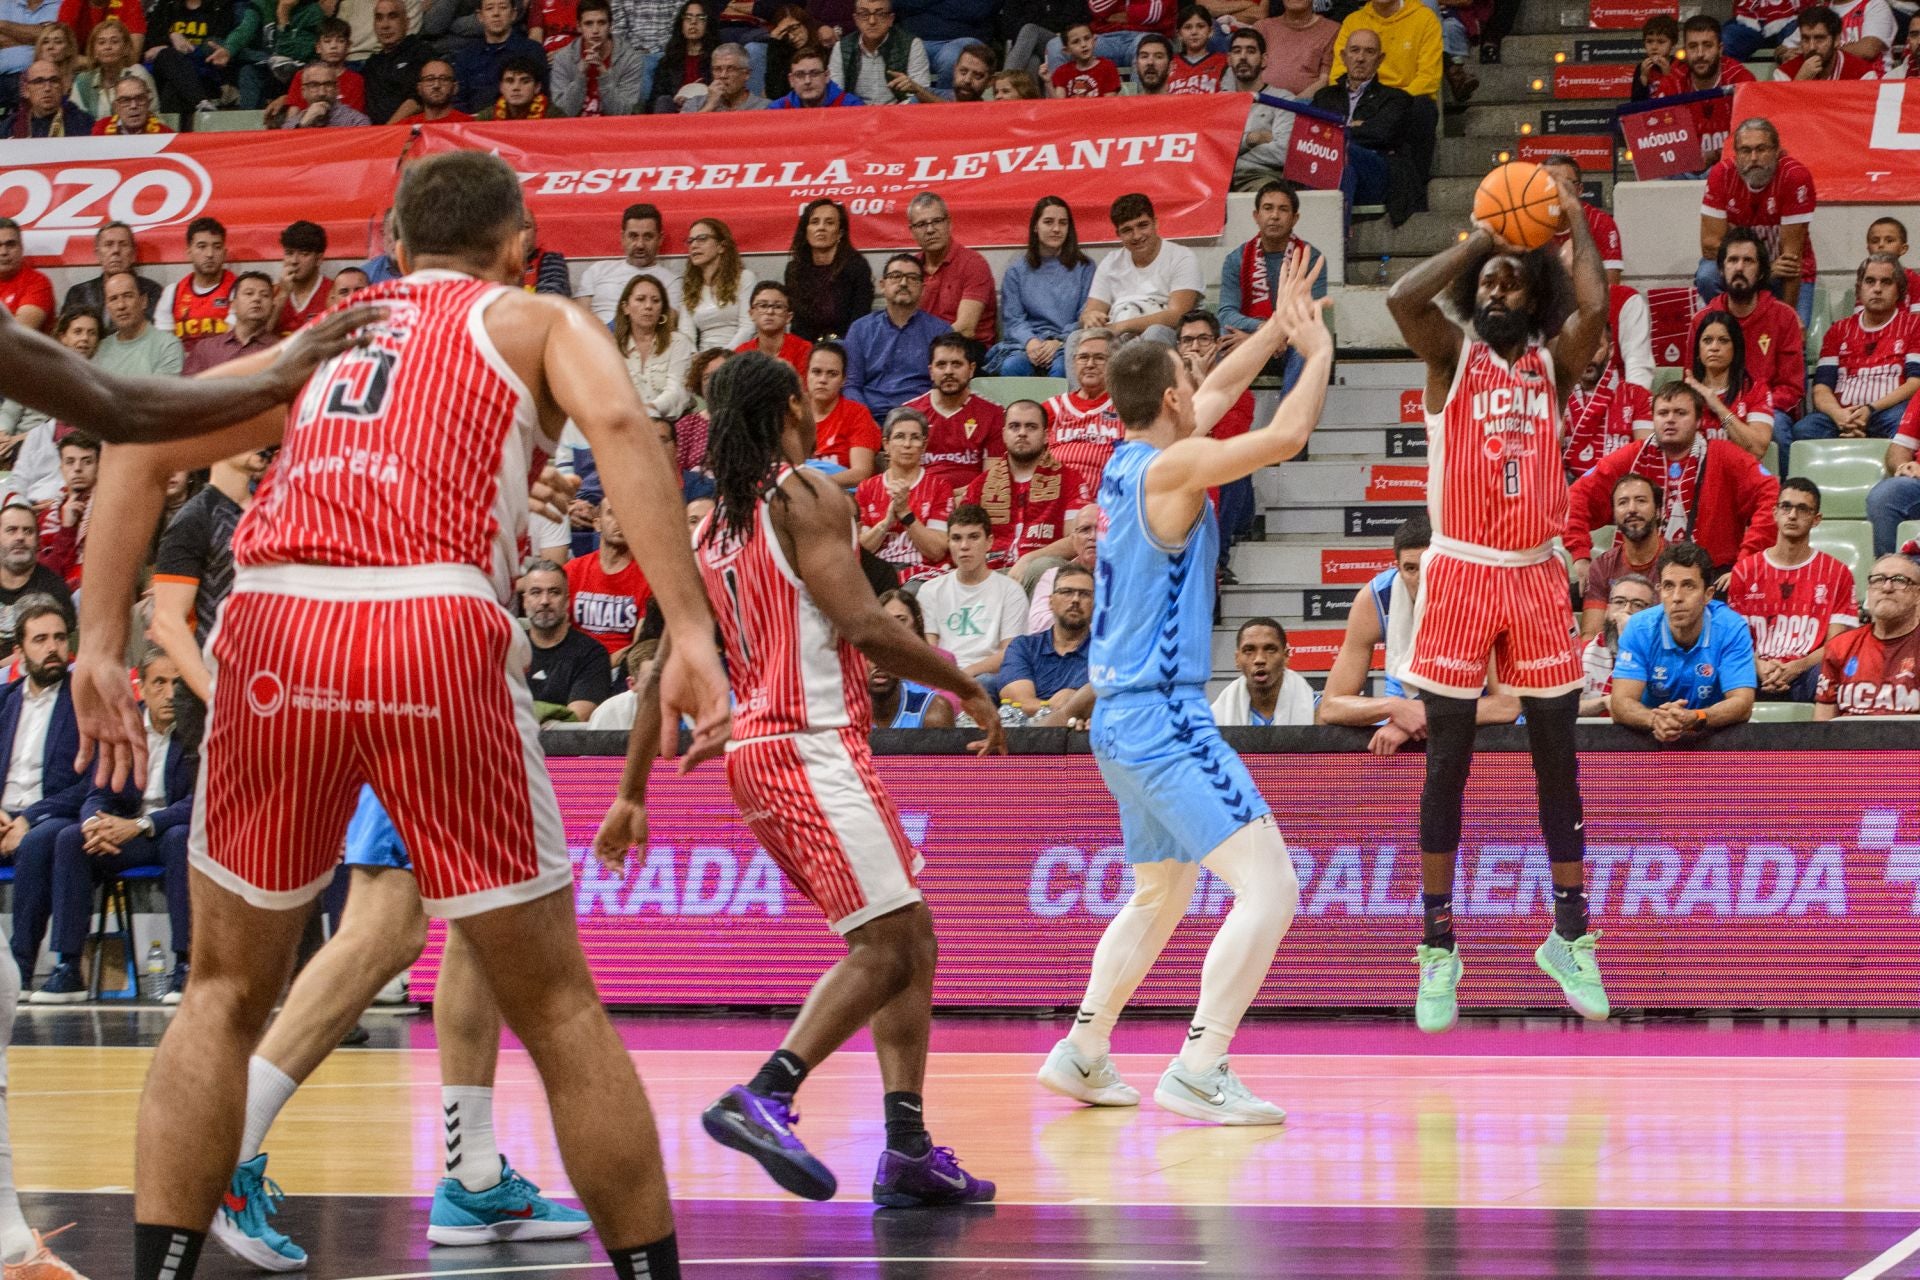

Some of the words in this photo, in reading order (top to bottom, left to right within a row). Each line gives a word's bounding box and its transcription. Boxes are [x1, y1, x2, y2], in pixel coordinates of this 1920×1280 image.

[1296, 139, 1339, 161] MÓDULO
[1637, 129, 1689, 150] MÓDULO
[536, 158, 853, 195] ESTRELLA
[863, 163, 906, 176] DE
[908, 132, 1198, 182] LEVANTE
[1660, 149, 1676, 163] 10
[1310, 161, 1319, 174] 9
[789, 185, 877, 198] MURCIA
[1472, 386, 1549, 420] UCAM
[1483, 417, 1536, 436] MURCIA
[1504, 459, 1521, 497] 8
[574, 599, 637, 629] FINALS
[1837, 682, 1920, 712] UCAM
[354, 699, 375, 714] DE
[380, 701, 441, 720] MURCIA
